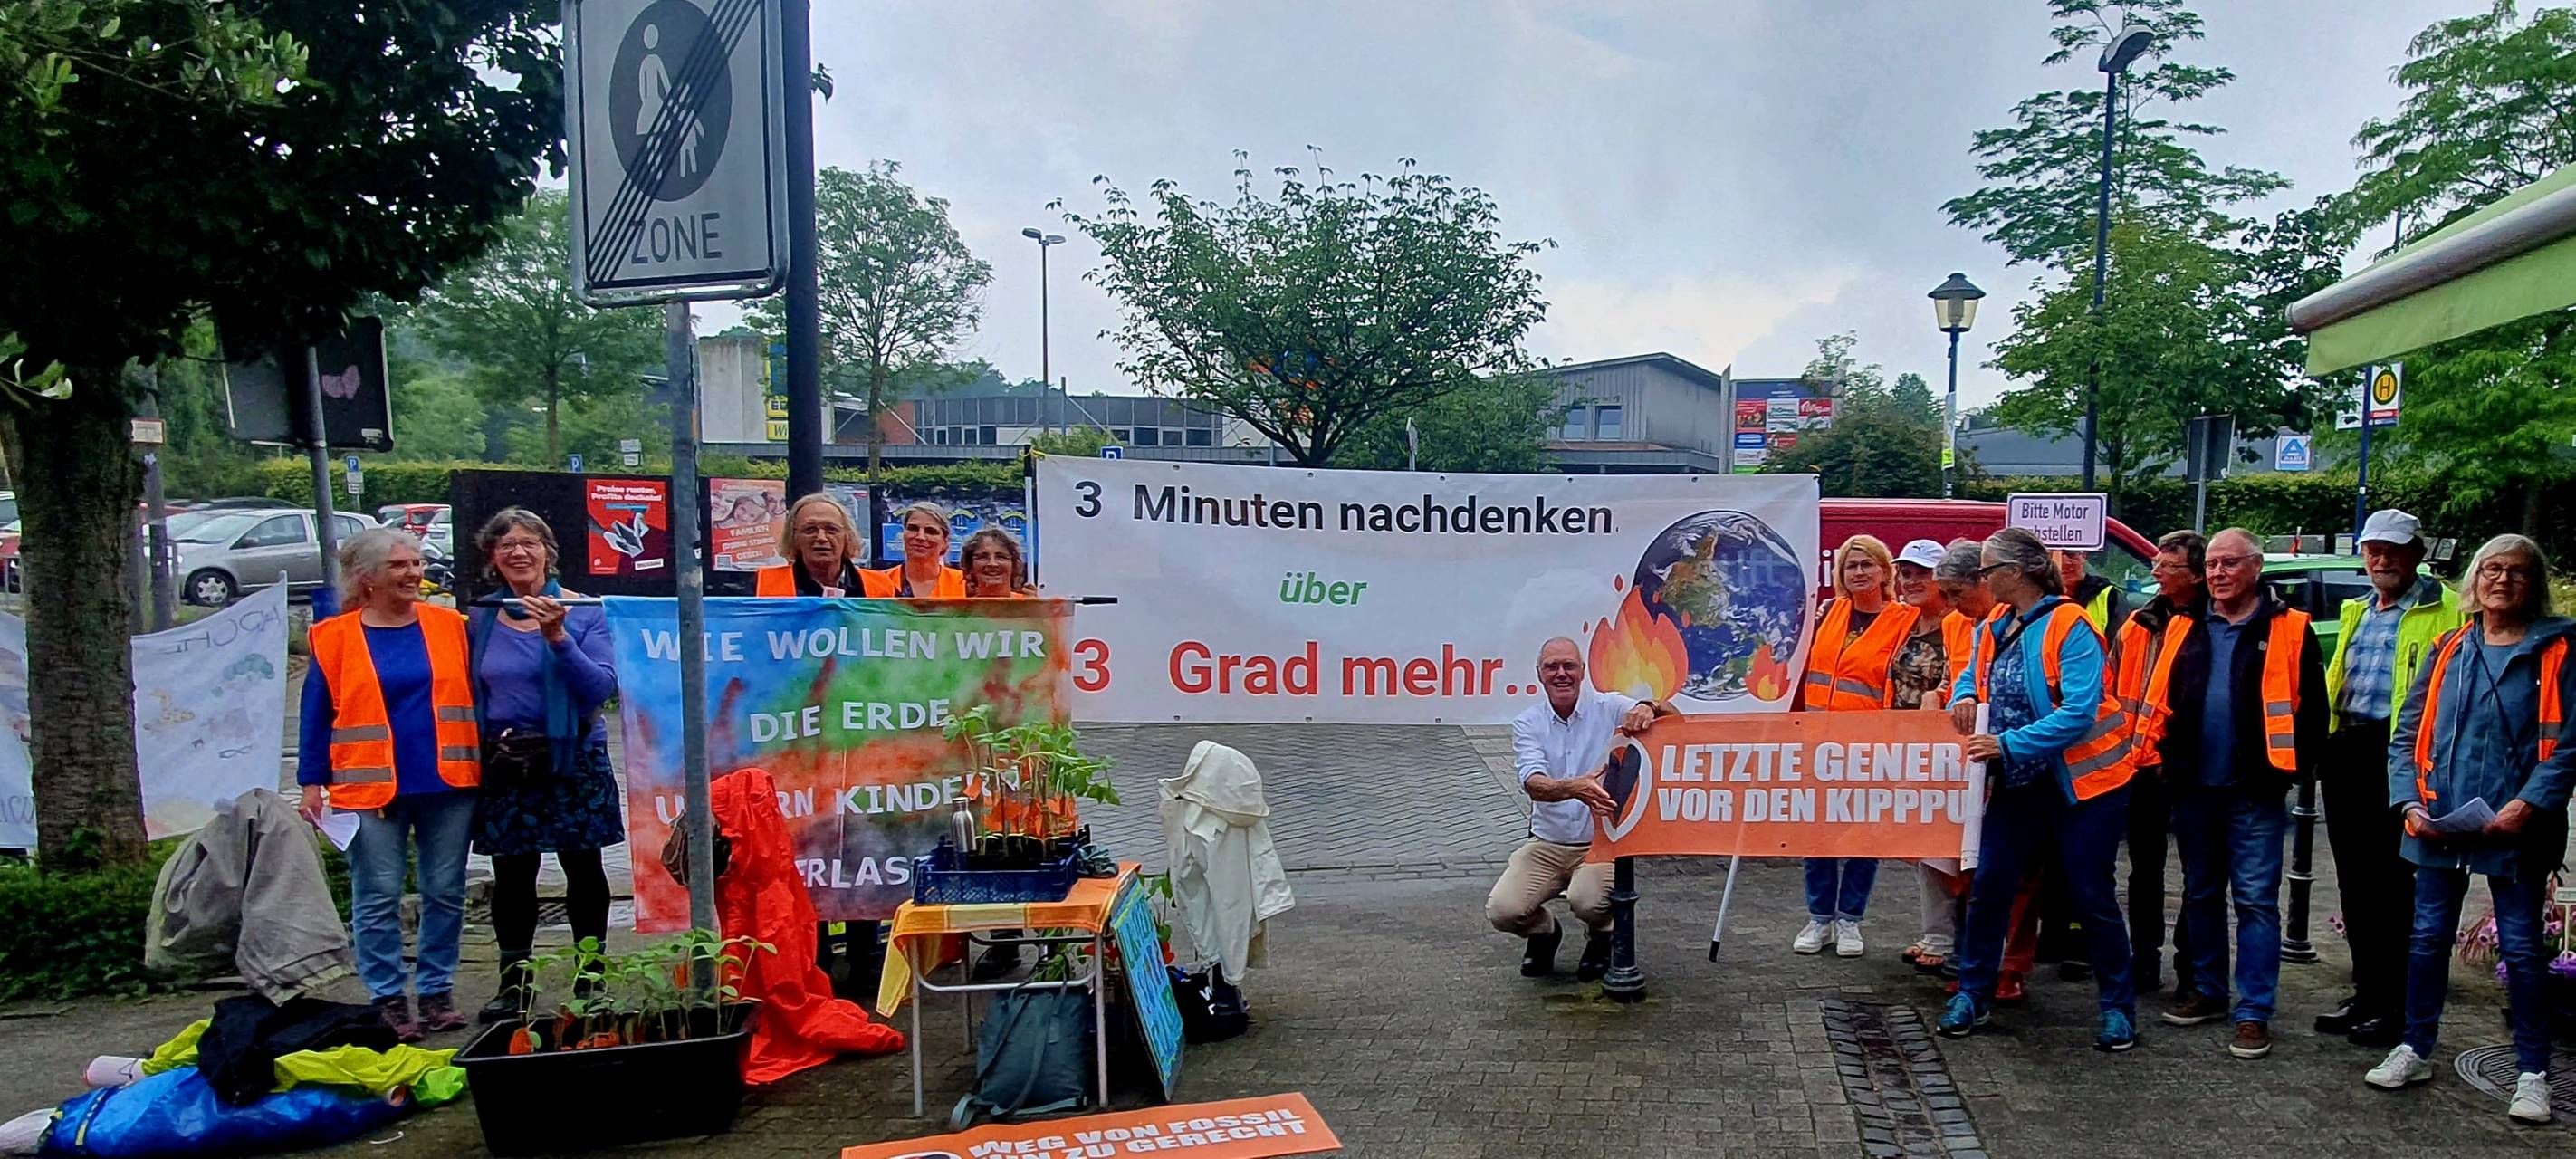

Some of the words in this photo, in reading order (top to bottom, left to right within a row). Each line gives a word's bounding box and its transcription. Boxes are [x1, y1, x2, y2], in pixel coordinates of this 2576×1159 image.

[631, 212, 722, 264] ZONE
[2380, 377, 2391, 398] H
[1075, 480, 1102, 518] 3
[1134, 484, 1323, 531] Minuten
[2021, 503, 2049, 519] Bitte
[2054, 503, 2089, 519] Motor
[2033, 524, 2083, 541] bstellen
[1278, 572, 1368, 606] über
[641, 628, 744, 662] WIE
[768, 627, 936, 661] WOLLEN
[955, 630, 1045, 660] WIR
[1073, 638, 1111, 693] 3
[1169, 641, 1319, 696] Grad
[750, 705, 821, 743] DIE
[842, 699, 950, 732] ERDE
[1661, 742, 1802, 783] LETZTE
[1815, 742, 1971, 782] GENER
[1657, 788, 1732, 823] VOR
[1743, 788, 1815, 824] DEN
[969, 1135, 1066, 1158] WEG
[1074, 1124, 1161, 1145] VON
[1168, 1108, 1302, 1135] FOSSIL
[1062, 1143, 1116, 1159] ZU
[1125, 1119, 1307, 1153] GERECHT
